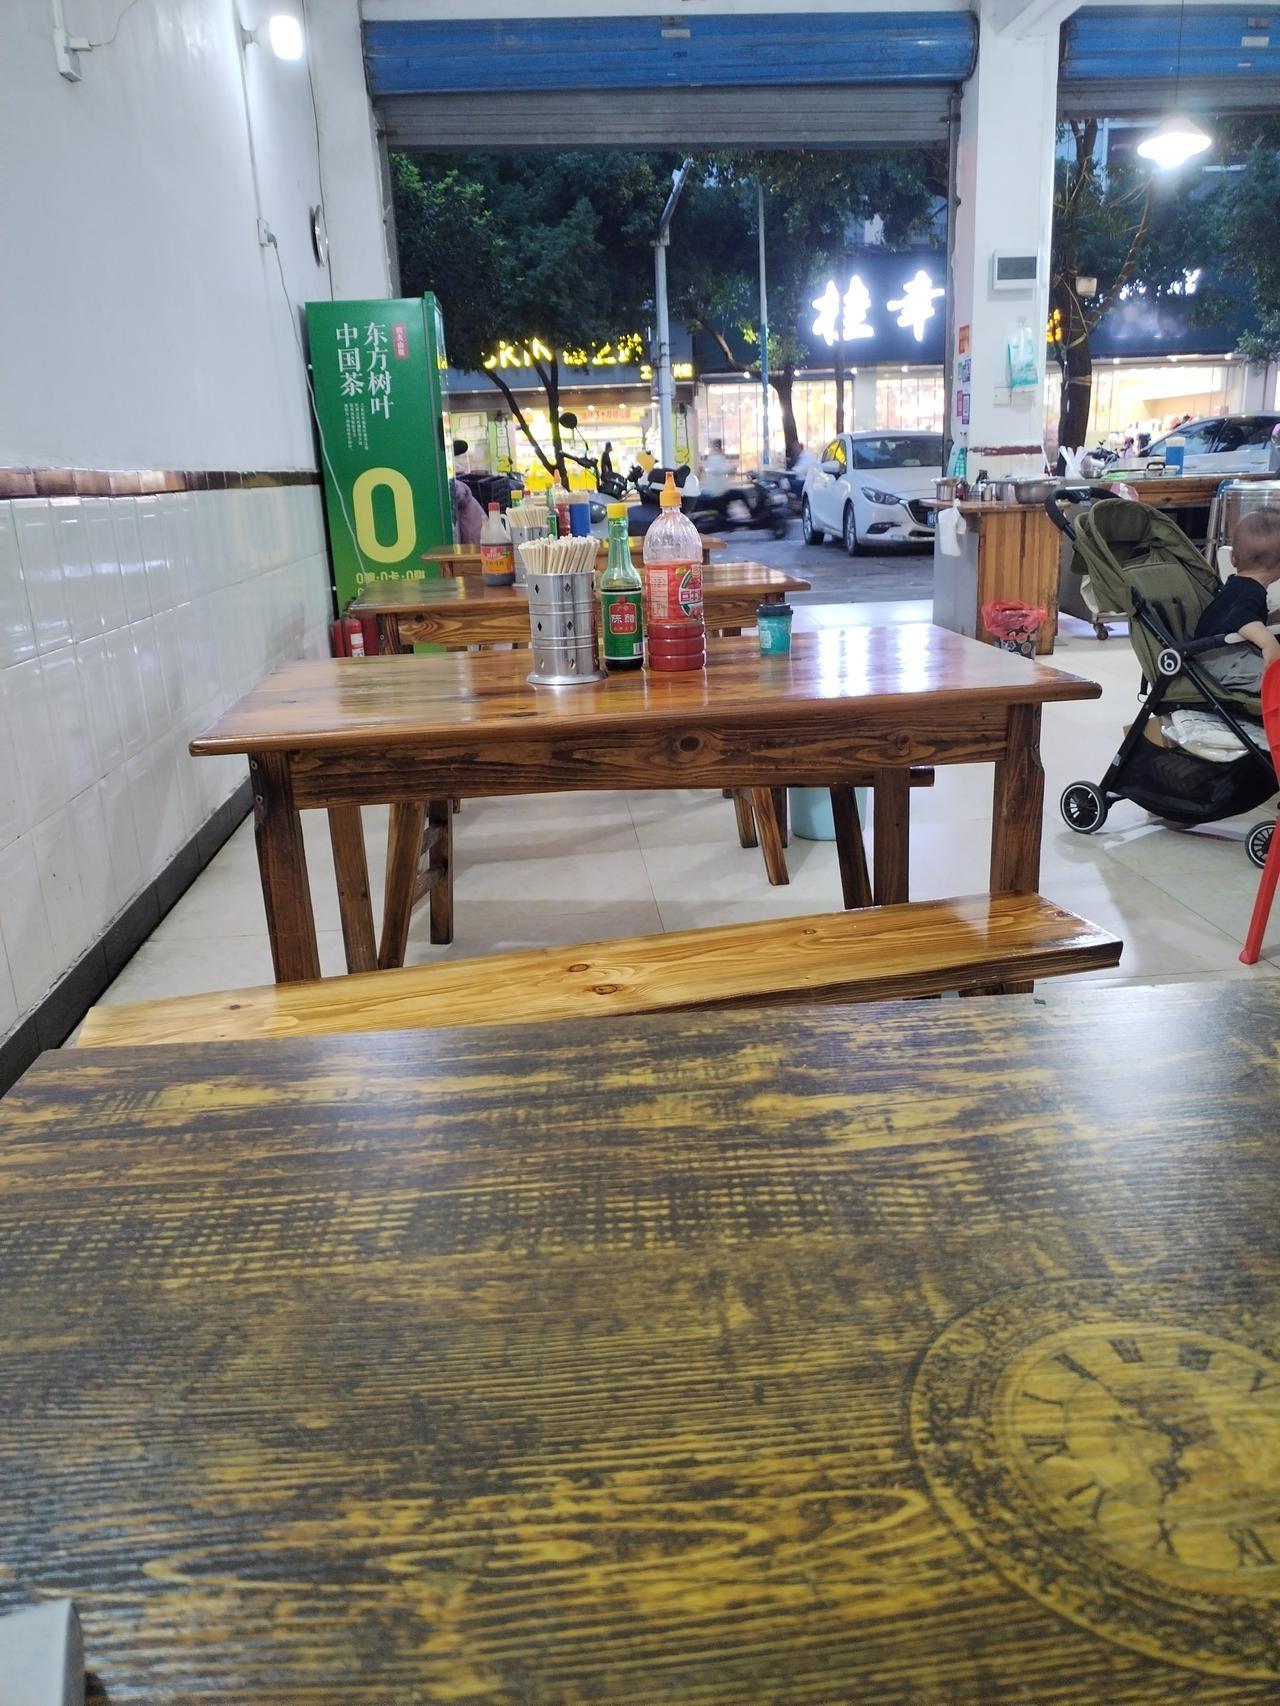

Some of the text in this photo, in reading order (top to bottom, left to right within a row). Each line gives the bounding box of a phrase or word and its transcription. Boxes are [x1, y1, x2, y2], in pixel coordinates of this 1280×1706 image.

[336, 323, 364, 397] 中国茶
[364, 322, 394, 420] 东方树叶
[353, 467, 417, 563] 0
